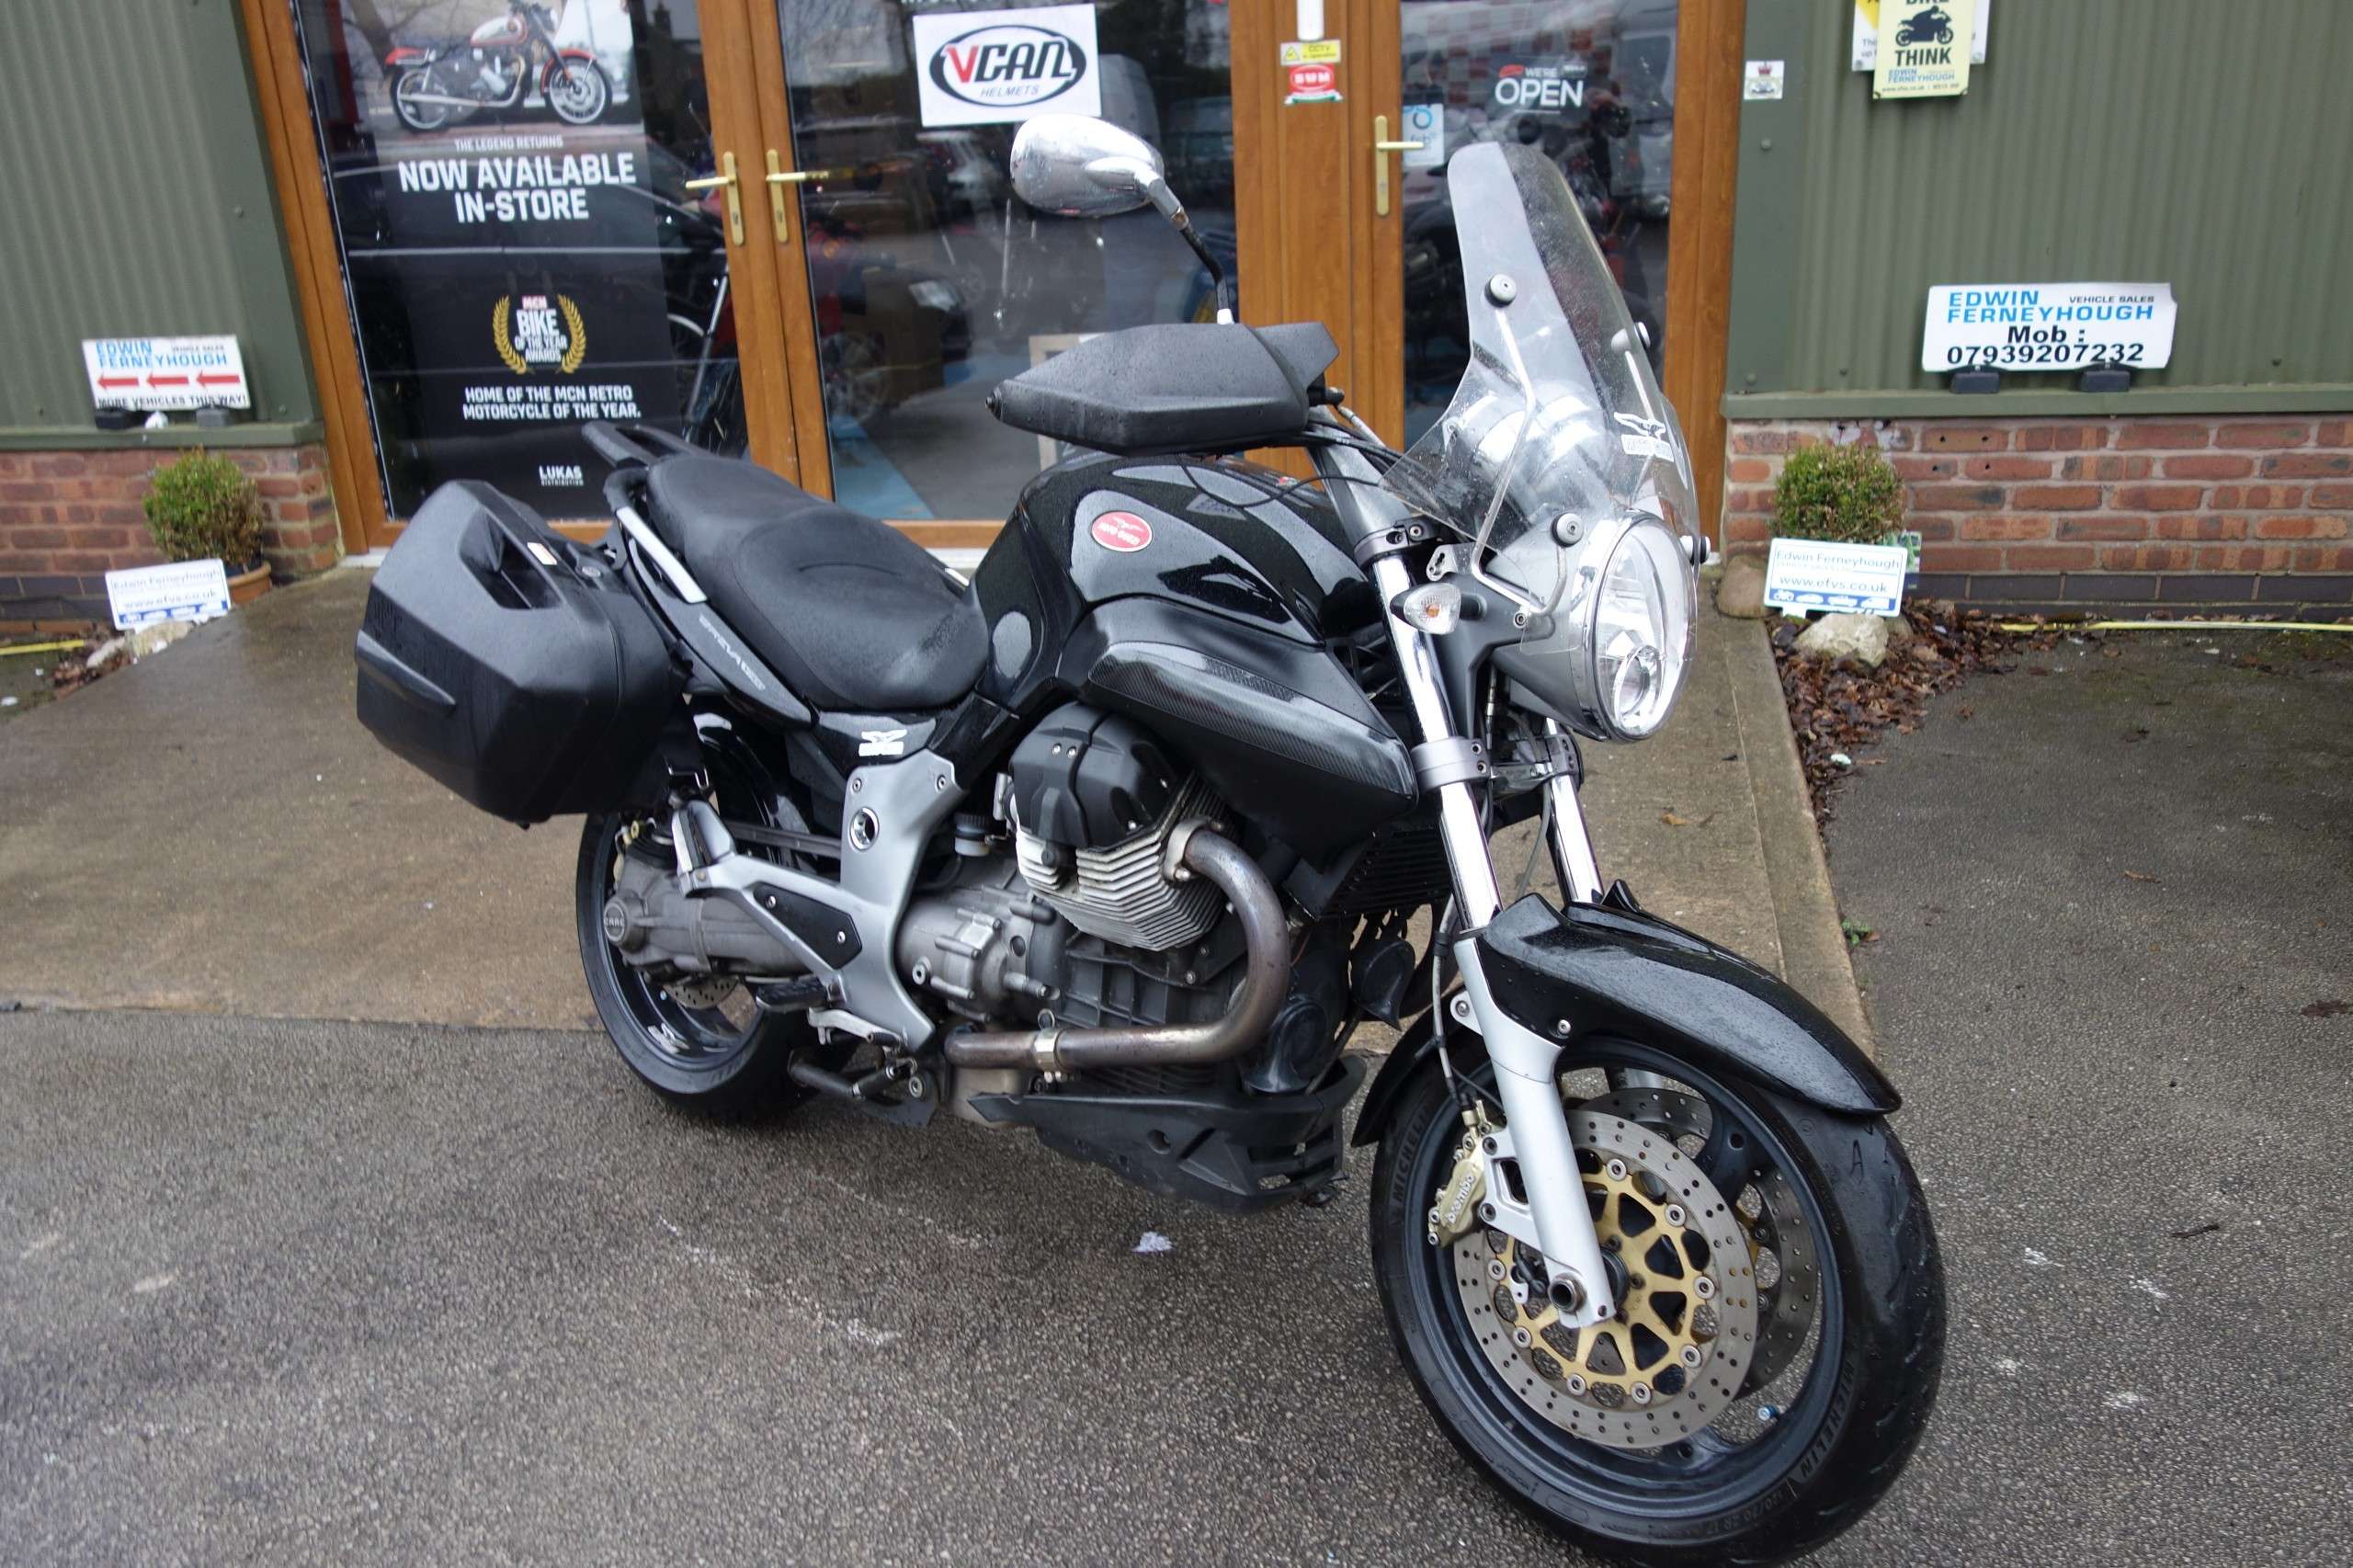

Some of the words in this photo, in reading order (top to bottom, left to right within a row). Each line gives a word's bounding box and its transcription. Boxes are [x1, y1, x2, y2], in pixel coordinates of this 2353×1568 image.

[945, 40, 1074, 83] VCAN
[1895, 47, 1952, 66] THINK
[1888, 74, 1955, 84] FERNEYHOUGH
[980, 85, 1040, 97] HELMETS
[1495, 77, 1584, 108] OPEN
[454, 139, 473, 152] THE
[474, 137, 514, 151] LEGEND
[516, 135, 563, 149] RETURNS
[398, 159, 469, 192] NOW
[477, 152, 636, 189] AVAILABLE
[454, 188, 589, 222] IN-STORE
[1949, 290, 2040, 307] EDWIN
[517, 309, 560, 336] BIKE
[1948, 305, 2154, 323] FERNEYHOUGH
[2007, 325, 2067, 343] Mob
[96, 340, 153, 355] EDWIN
[1947, 343, 2144, 365] 07939207232
[97, 352, 228, 369] FERNEYHOUGH
[98, 397, 129, 409] MORE
[132, 396, 186, 408] VEHICLES
[188, 395, 214, 407] THIS
[216, 394, 246, 406] WAY!
[465, 386, 504, 403] HOME
[506, 386, 524, 403] OF
[525, 386, 551, 403] THE
[553, 386, 586, 402] MCN
[588, 385, 633, 401] RETRO
[462, 403, 551, 420] MOTORCYCLE
[552, 403, 570, 418] OF
[573, 403, 599, 418] THE
[600, 402, 642, 418] YEAR.
[539, 465, 583, 479] LUKAS
[1776, 551, 1813, 562] Edwin
[1817, 553, 1900, 569] Ferneyhough
[1446, 1174, 1476, 1224] brembo
[1799, 1359, 1855, 1479] MICHELIN
